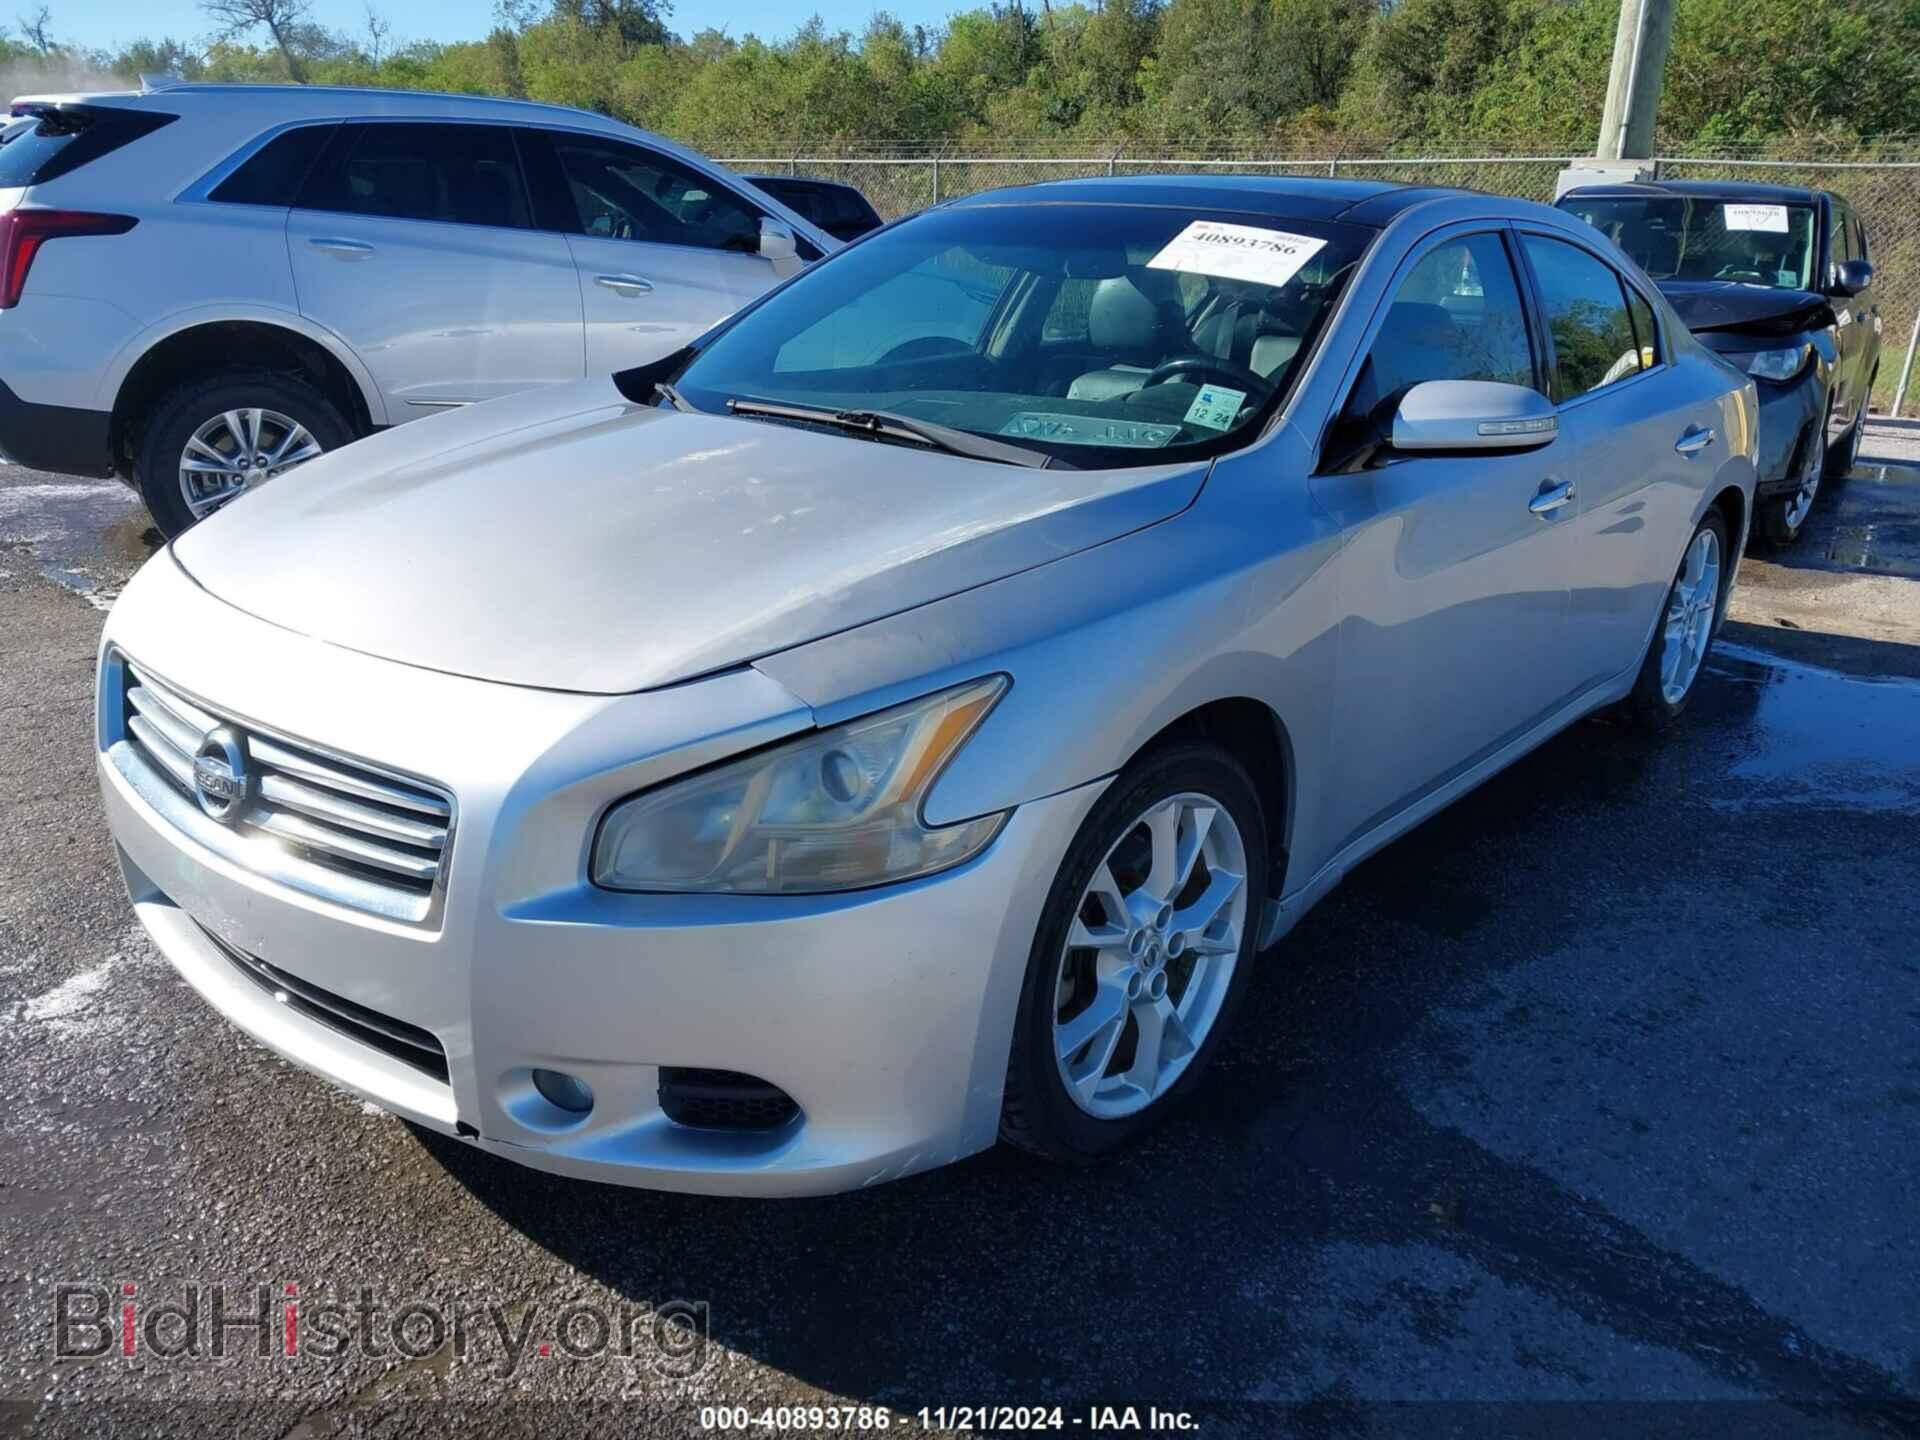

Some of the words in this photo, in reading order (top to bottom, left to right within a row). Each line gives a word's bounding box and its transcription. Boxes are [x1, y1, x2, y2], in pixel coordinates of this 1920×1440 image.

[1192, 231, 1297, 255] 40893786
[1194, 407, 1209, 418] 12
[1213, 412, 1230, 424] 24
[196, 769, 234, 796] SSAN
